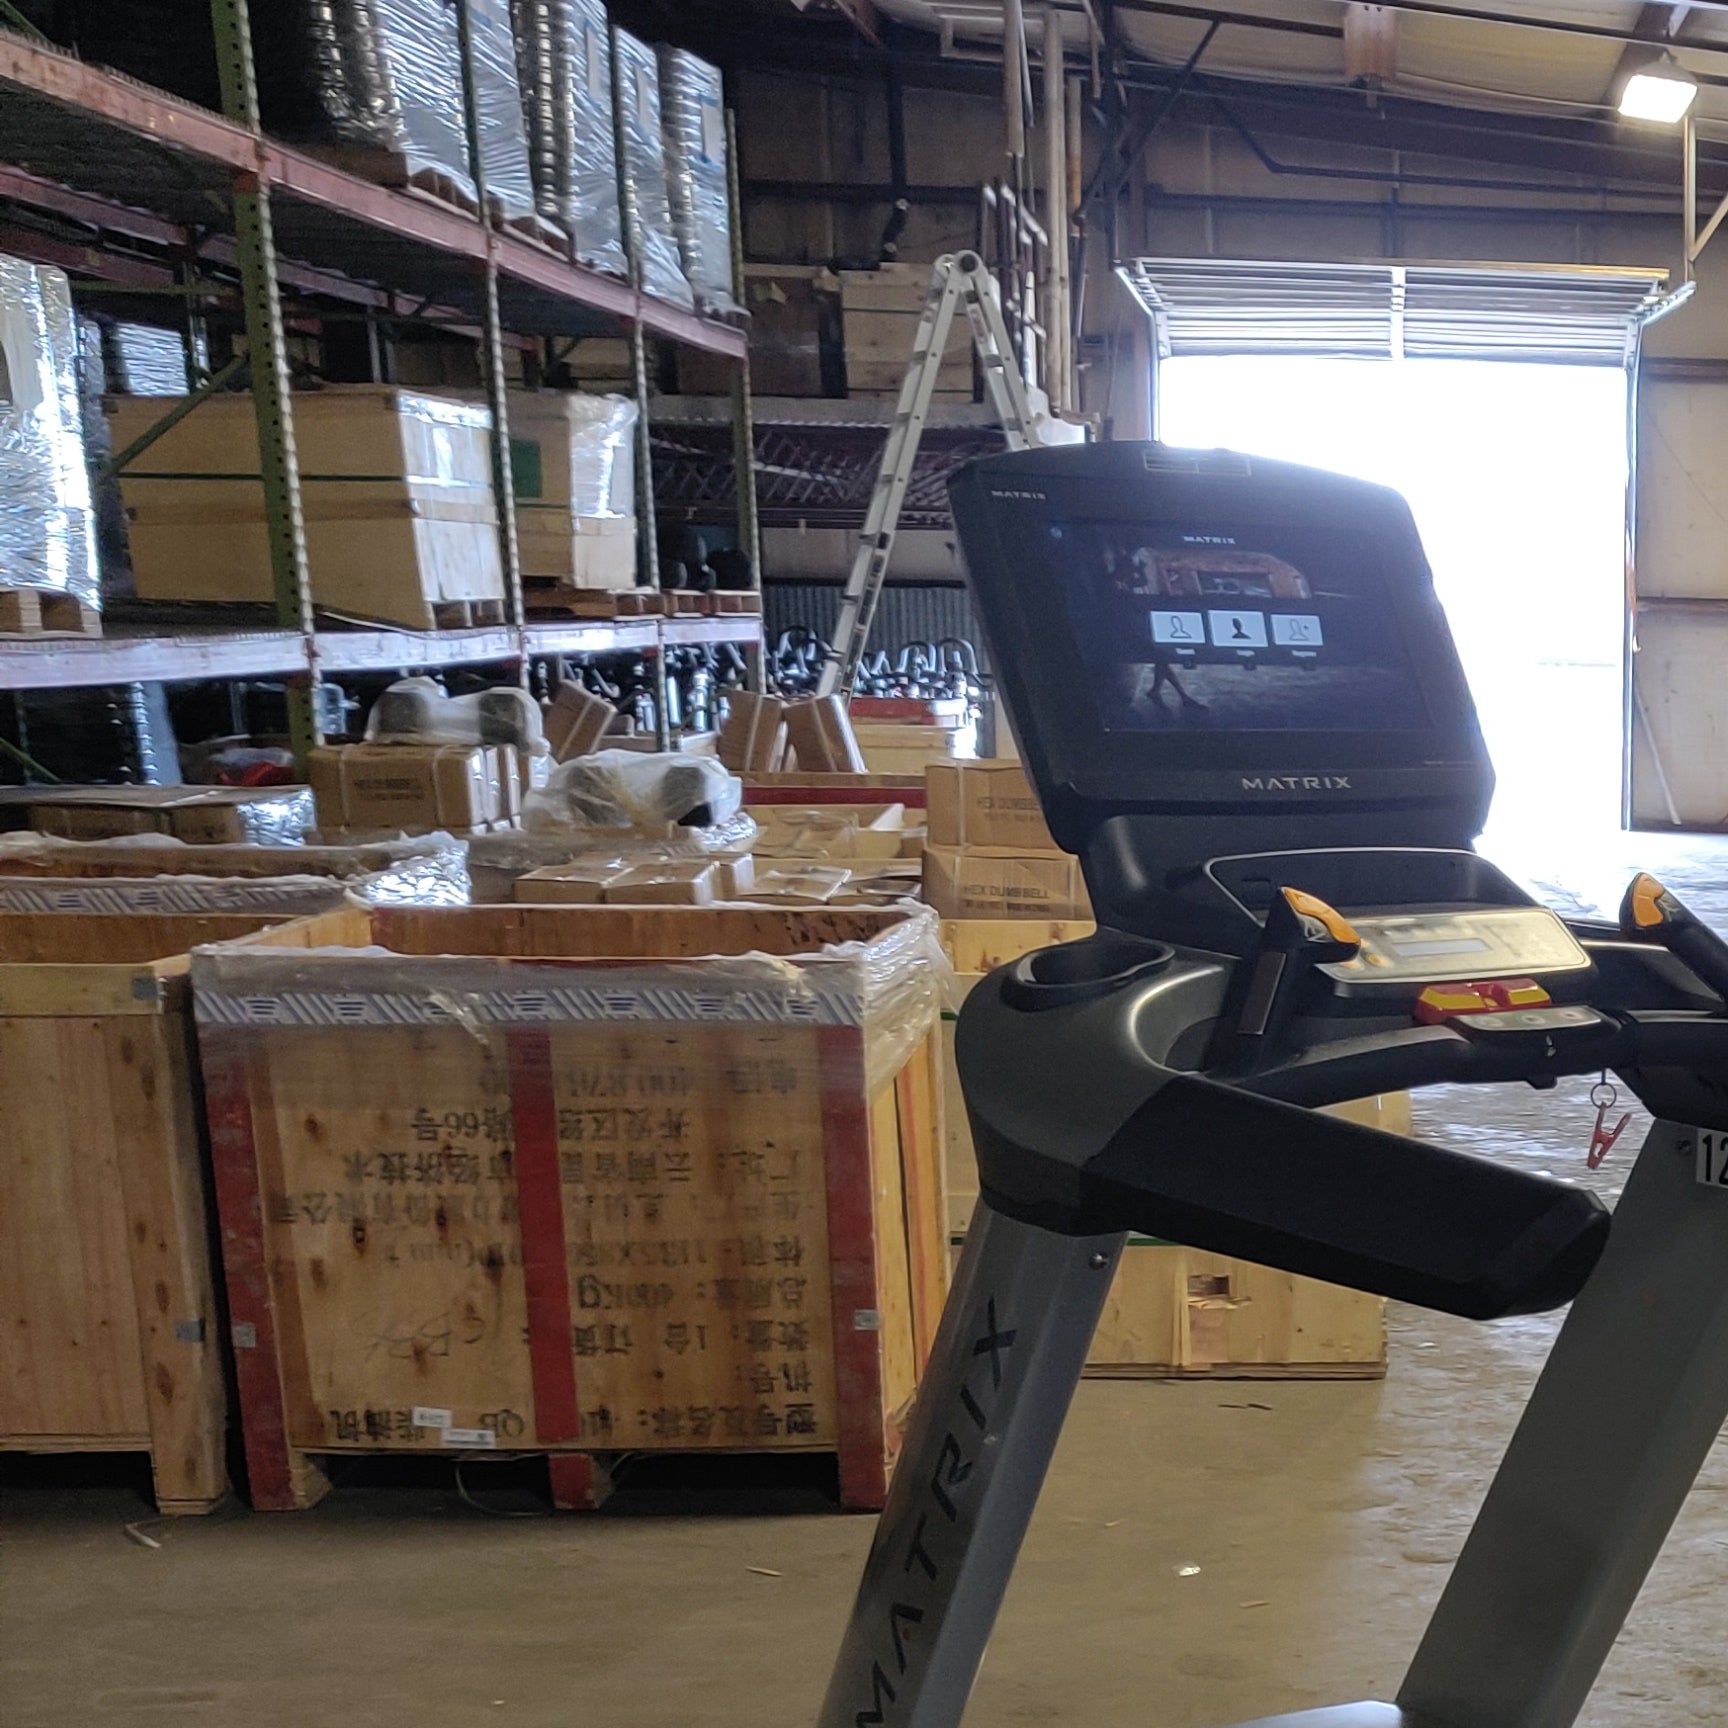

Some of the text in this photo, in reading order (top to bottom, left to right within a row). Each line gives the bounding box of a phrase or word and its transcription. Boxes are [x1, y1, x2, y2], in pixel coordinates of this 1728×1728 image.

[991, 490, 1046, 500] MATRIX
[1182, 535, 1236, 545] MATRIX
[1241, 776, 1352, 790] MATRIX
